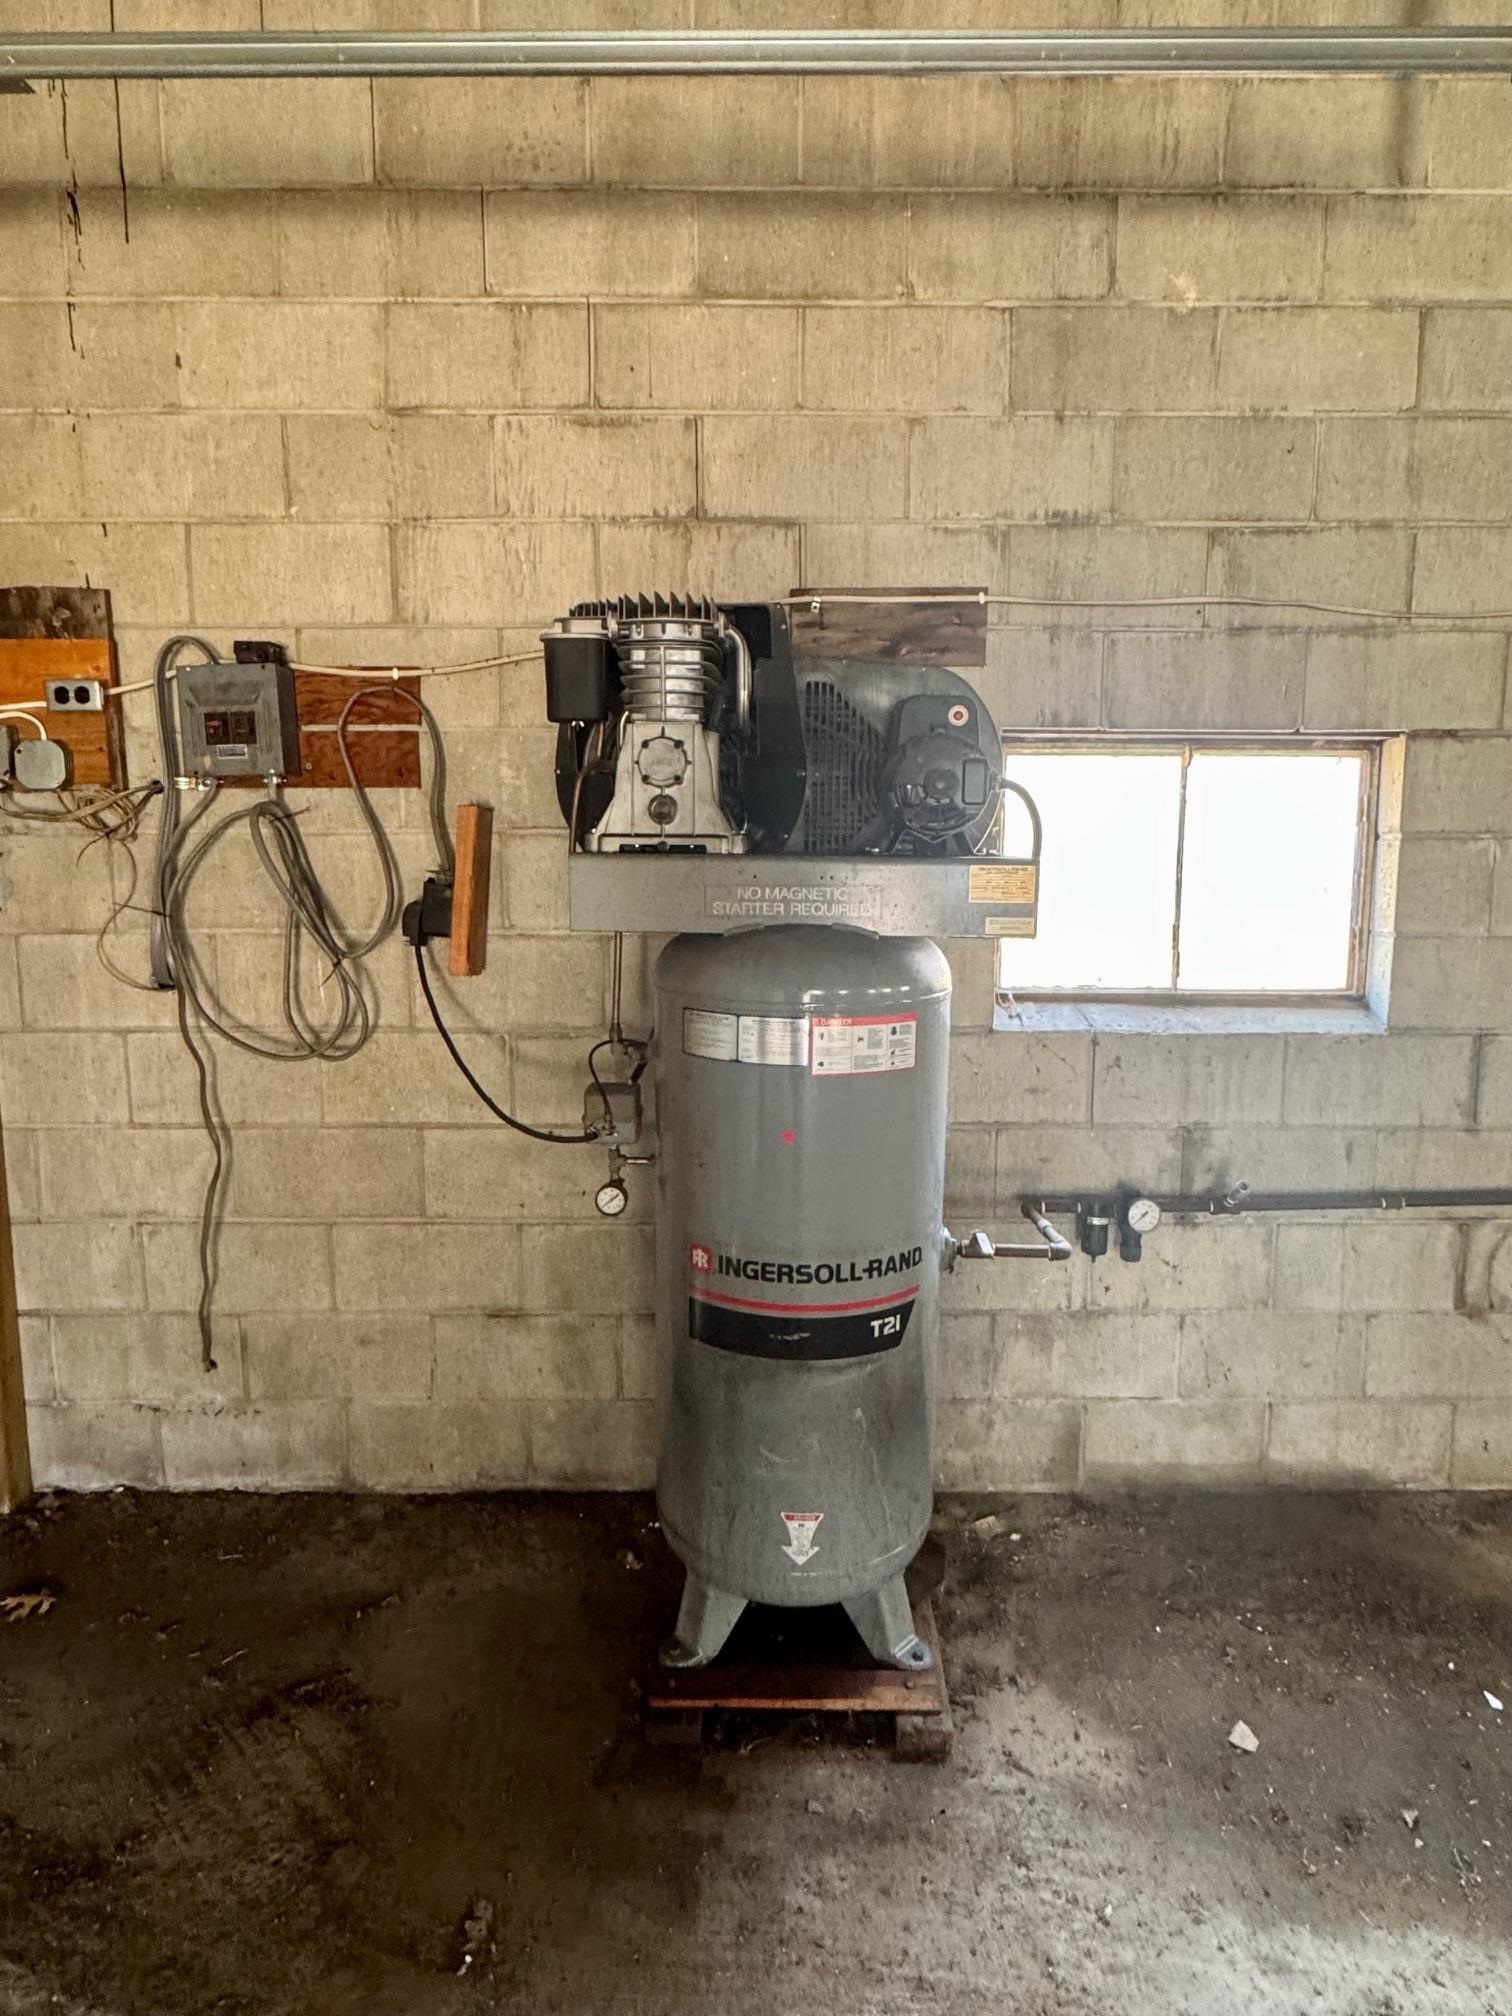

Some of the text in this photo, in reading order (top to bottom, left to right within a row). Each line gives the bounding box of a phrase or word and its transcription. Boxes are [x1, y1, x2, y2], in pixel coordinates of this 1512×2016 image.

[737, 887, 849, 900] NO MAGNETIC
[712, 902, 872, 916] STARTER REQUIRED
[821, 1018, 852, 1026] DANGER
[718, 1246, 923, 1284] INGERSOLL-RAND
